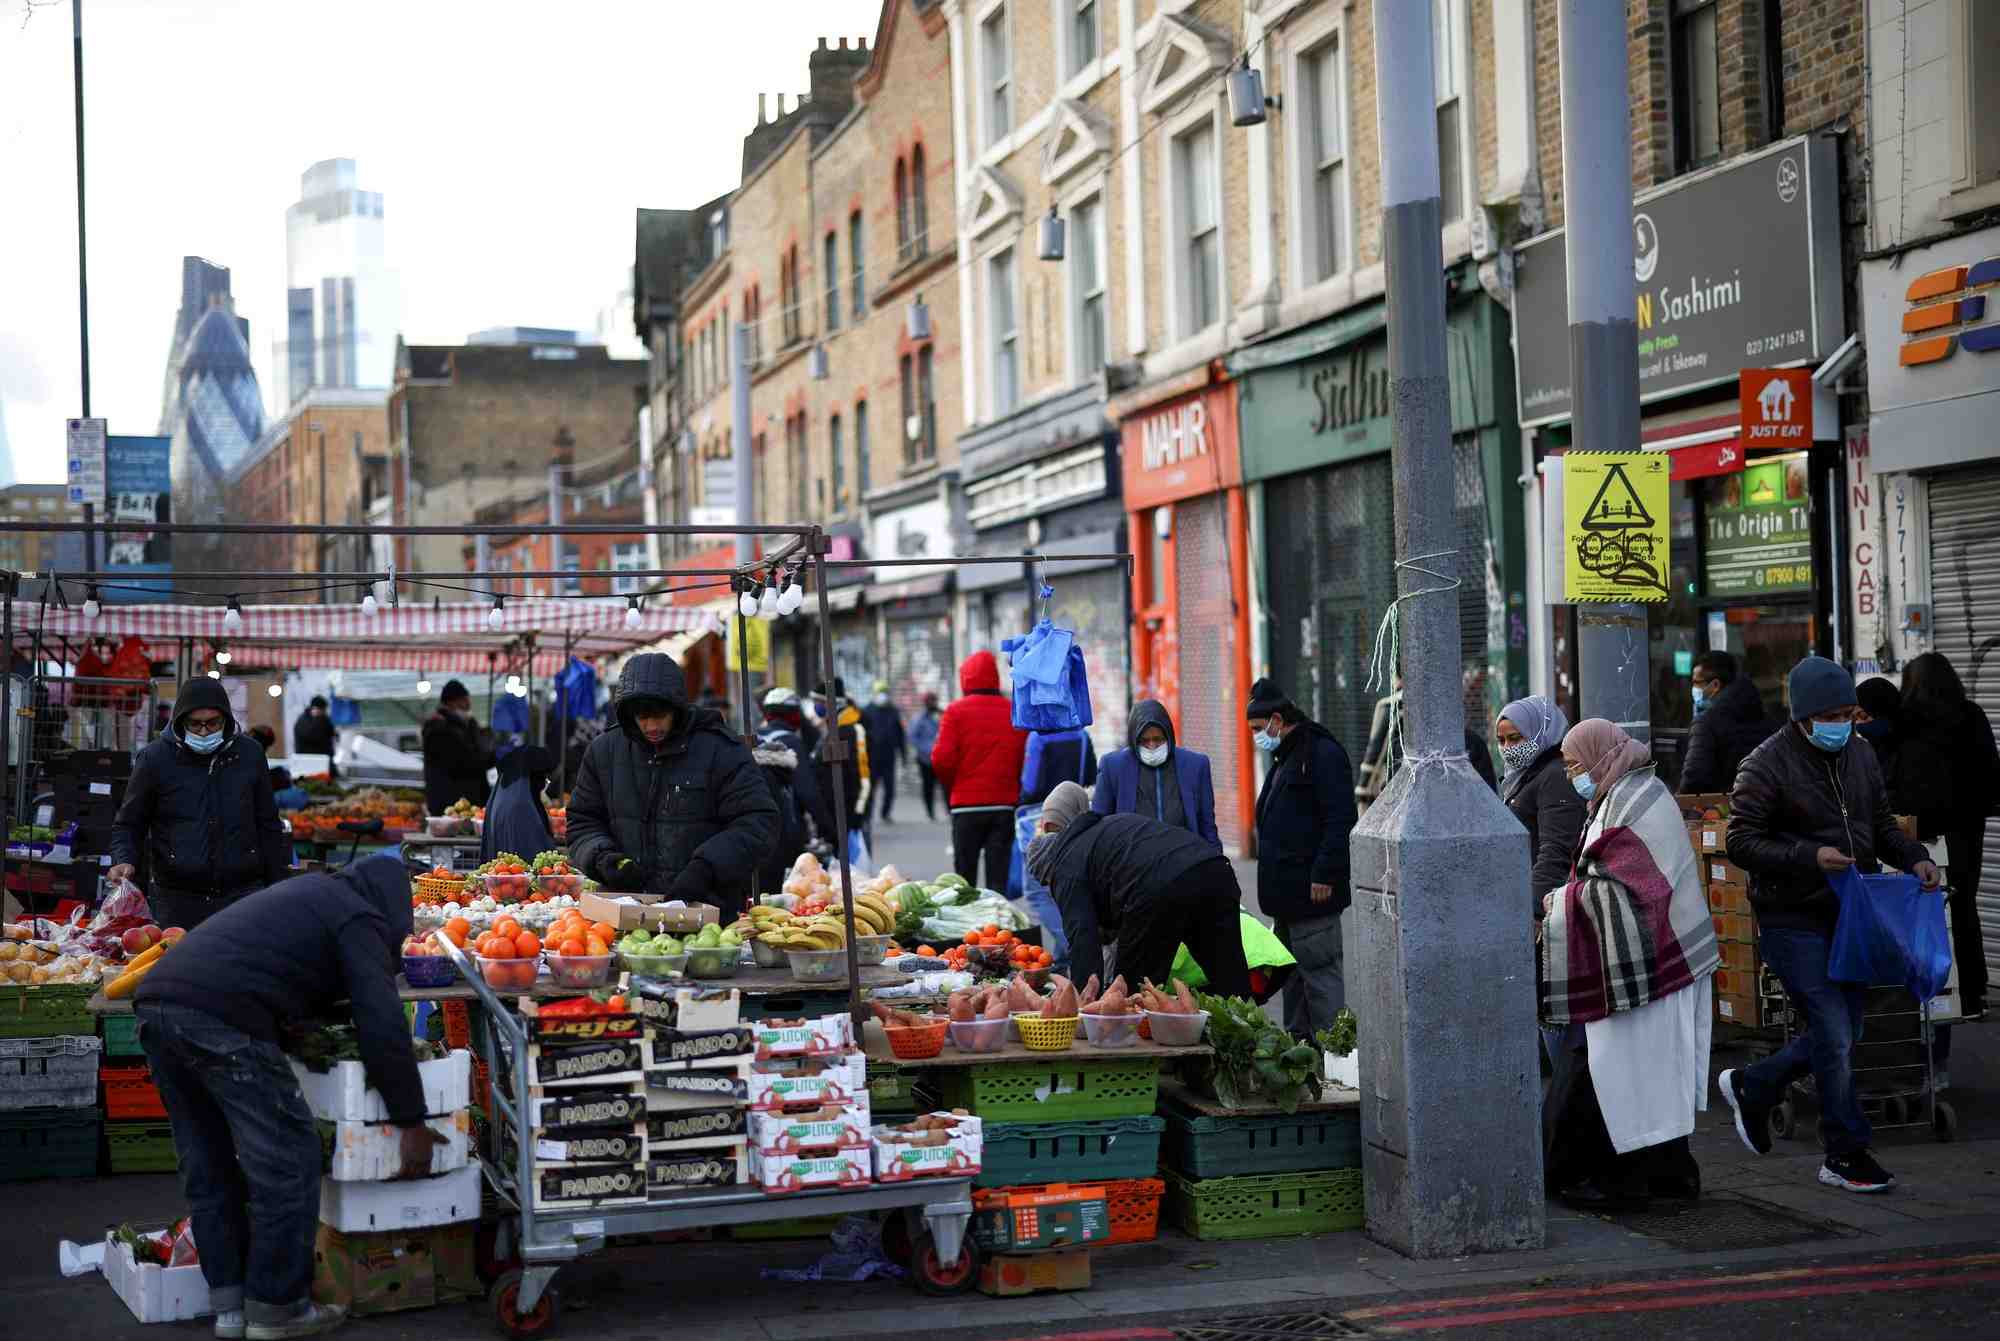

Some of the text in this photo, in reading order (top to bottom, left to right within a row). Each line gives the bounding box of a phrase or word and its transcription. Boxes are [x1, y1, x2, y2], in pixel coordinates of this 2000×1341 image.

[1660, 269, 1741, 324] Sashimi
[1141, 400, 1206, 472] MAHIR
[1750, 424, 1804, 439] JUST EAT
[1708, 517, 1734, 540] The
[1738, 511, 1784, 540] Origin
[1790, 506, 1809, 530] Th
[1849, 434, 1875, 616] MINI CAB
[1766, 567, 1794, 585] 07900
[1795, 564, 1811, 583] 491
[672, 1033, 738, 1060] PARDO
[556, 1048, 626, 1078] PARDO
[667, 1077, 733, 1092] PARDO
[560, 1100, 629, 1126] PARDO
[664, 1112, 732, 1138] PARDO
[567, 1137, 626, 1158] ARDO
[656, 1161, 722, 1183] PARDO
[561, 1173, 631, 1198] PARDO
